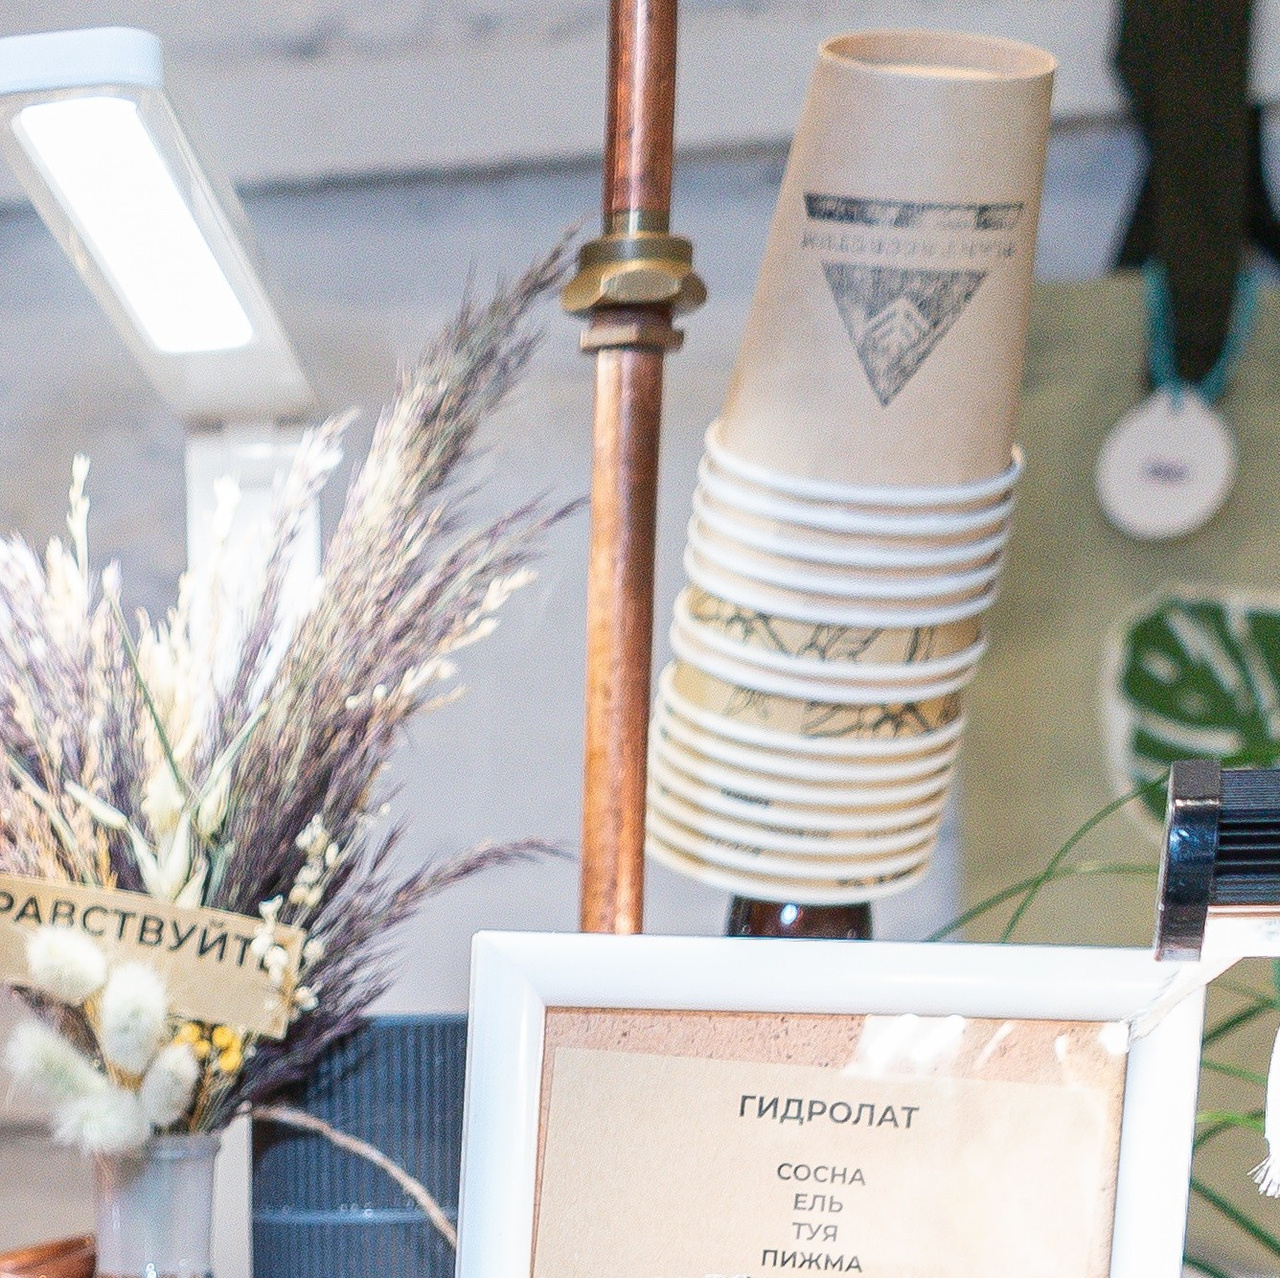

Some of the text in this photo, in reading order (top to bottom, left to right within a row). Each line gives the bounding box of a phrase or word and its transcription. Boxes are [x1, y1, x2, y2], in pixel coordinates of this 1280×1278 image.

[738, 1095, 920, 1129] ГИДРОЛАТ
[776, 1162, 866, 1186] СОСНА
[792, 1193, 844, 1213] ЕЛЬ
[791, 1222, 839, 1242] ТУЯ
[761, 1249, 863, 1273] ПИЖМА
